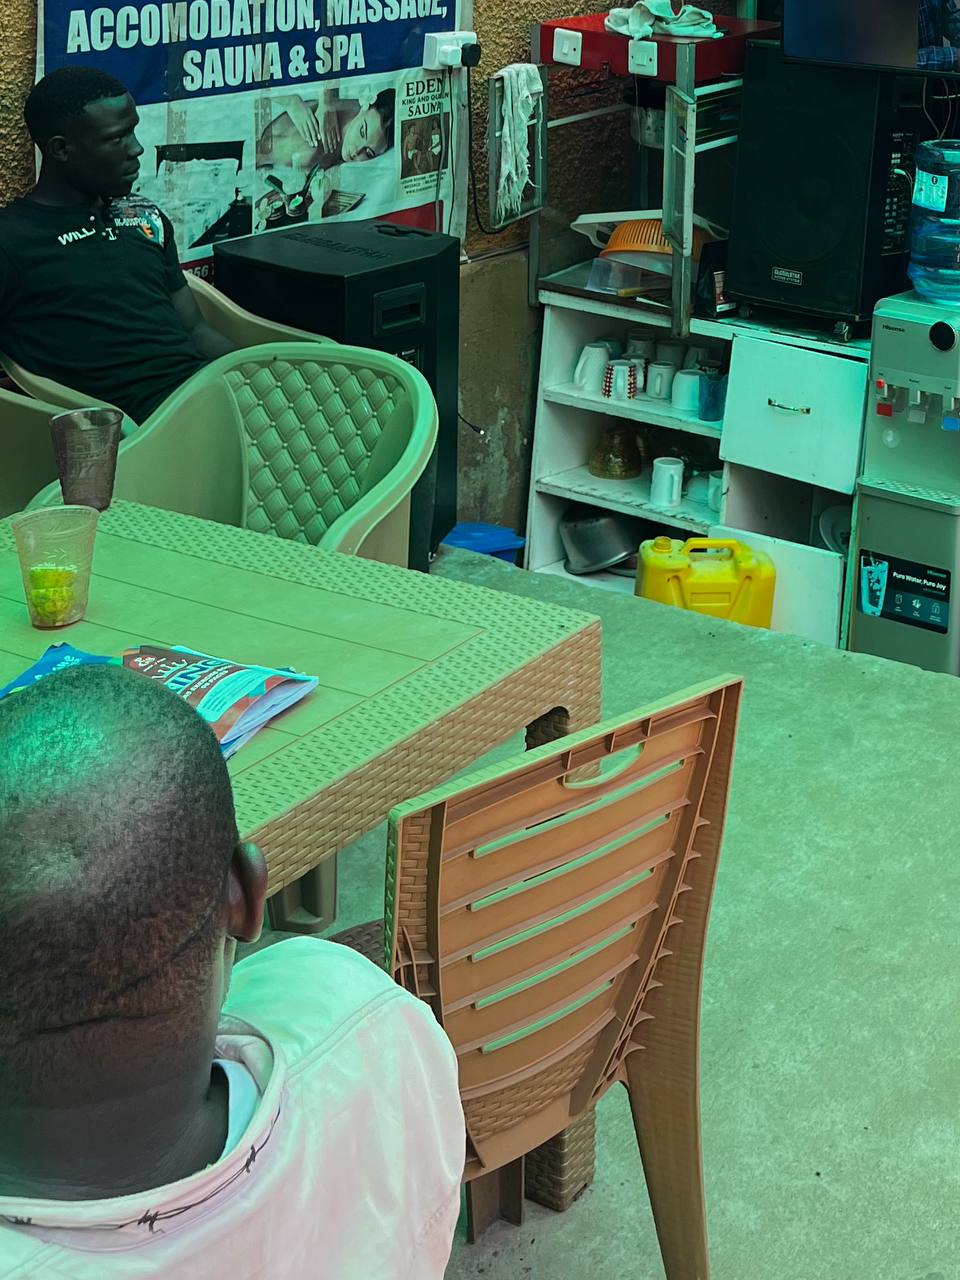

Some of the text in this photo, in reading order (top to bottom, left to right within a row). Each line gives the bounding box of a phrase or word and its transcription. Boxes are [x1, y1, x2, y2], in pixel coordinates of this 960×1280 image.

[182, 32, 366, 93] SAUNA & SPA
[417, 95, 430, 104] AND
[57, 226, 96, 246] WILL
[893, 571, 906, 581] Pure
[923, 578, 936, 588] Pure
[936, 581, 947, 592] Joy
